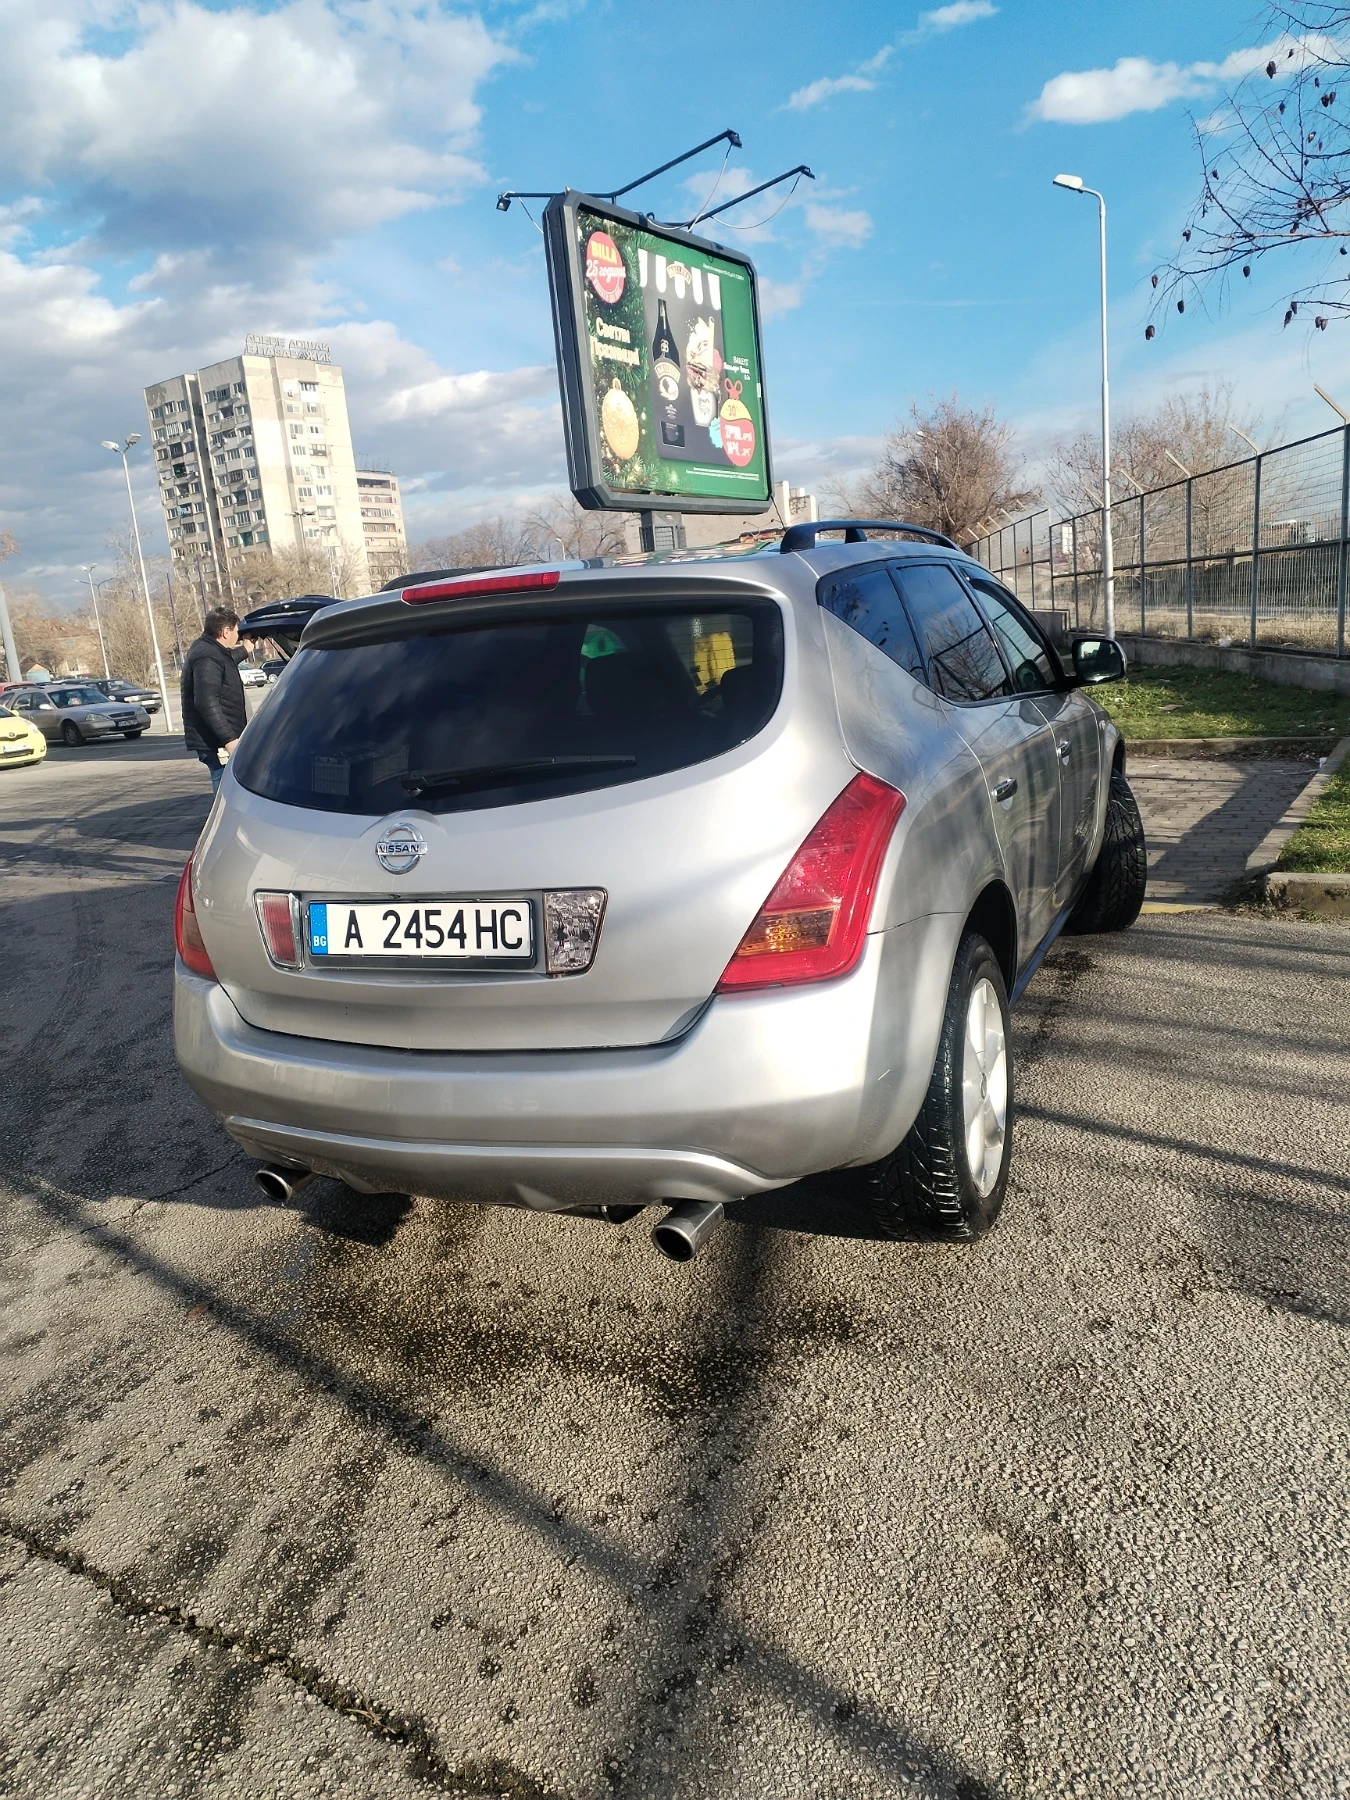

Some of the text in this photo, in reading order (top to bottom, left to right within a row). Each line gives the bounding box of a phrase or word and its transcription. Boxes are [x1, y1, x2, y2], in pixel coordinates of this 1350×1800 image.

[591, 240, 617, 264] BILLA
[586, 259, 599, 277] 25
[379, 844, 419, 853] NISSAN
[344, 909, 523, 950] A 2454 HC
[313, 935, 327, 947] BG
